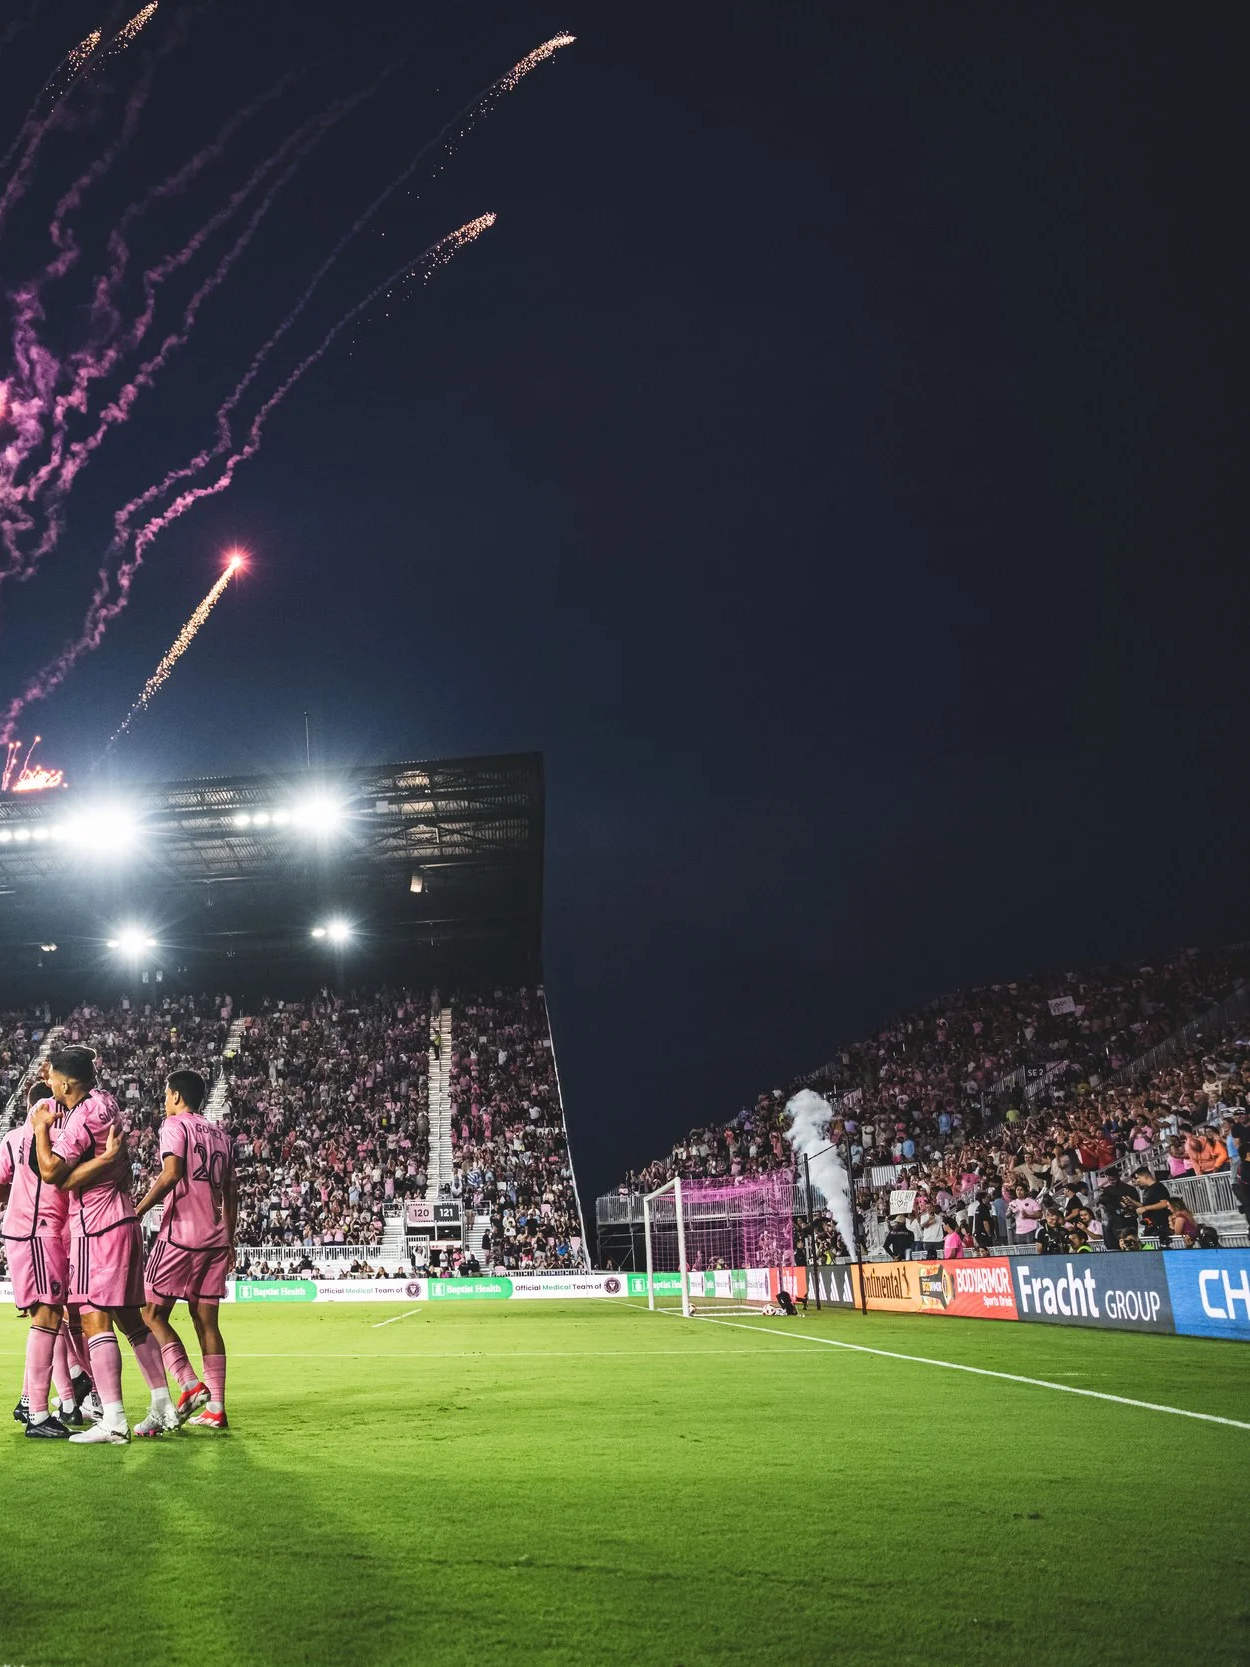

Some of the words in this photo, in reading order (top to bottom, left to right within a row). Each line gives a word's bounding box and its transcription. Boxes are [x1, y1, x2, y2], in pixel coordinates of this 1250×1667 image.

[1027, 1069, 1037, 1077] SE
[1038, 1068, 1044, 1076] 2
[193, 1142, 226, 1190] 20
[414, 1209, 430, 1217] 120
[440, 1208, 454, 1217] 121
[955, 1267, 1012, 1294] BODYARMOR
[253, 1287, 279, 1297] Baptist
[280, 1287, 306, 1296] Health
[446, 1285, 473, 1295] Baptist
[474, 1284, 501, 1293] Health
[1016, 1262, 1100, 1319] Fracht
[1104, 1289, 1161, 1322] GROUP
[983, 1295, 999, 1308] Sports
[999, 1295, 1014, 1308] Drink
